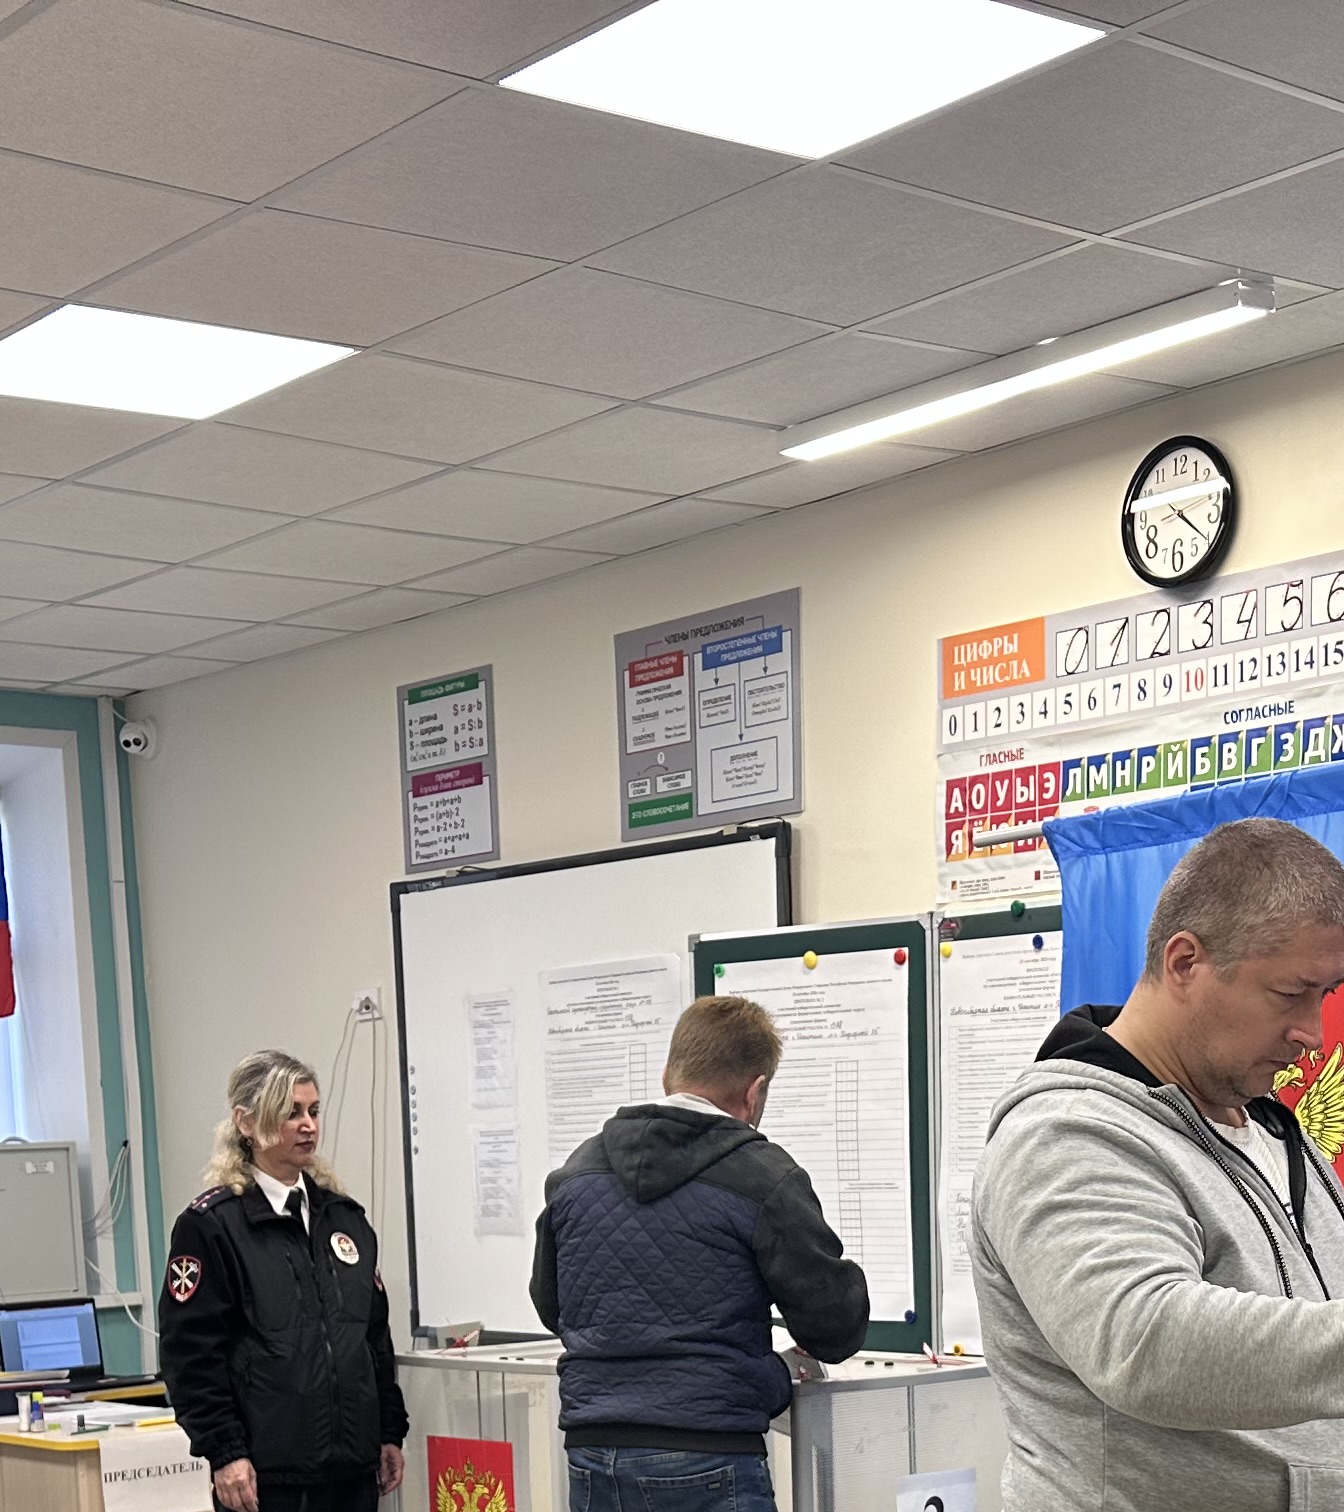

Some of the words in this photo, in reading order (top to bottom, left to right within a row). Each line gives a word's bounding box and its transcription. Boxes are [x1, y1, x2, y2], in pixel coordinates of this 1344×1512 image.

[1155, 468, 1165, 484] 11
[1173, 454, 1187, 476] 12
[1193, 460, 1199, 482] 1
[1208, 491, 1220, 523] 3
[1140, 510, 1147, 530] 9
[1146, 525, 1158, 559] 8
[1190, 537, 1198, 557] 5
[1172, 538, 1184, 572] 6
[1064, 627, 1089, 675] 0
[1110, 616, 1129, 667] 1
[1150, 609, 1170, 659] 2
[1192, 600, 1213, 649] 3
[1237, 591, 1257, 640] 4
[1281, 580, 1304, 631] 5
[953, 633, 1019, 667] ЦИФРЫ
[953, 672, 966, 691] И
[970, 658, 1031, 687] ЧИСЛА
[949, 714, 957, 736] 0
[972, 711, 978, 732] 1
[993, 706, 1002, 729] 2
[1016, 701, 1025, 724] 3
[1039, 696, 1048, 719] 4
[1063, 692, 1072, 715] 5
[1087, 687, 1097, 711] 6
[1112, 683, 1121, 706] 7
[1137, 678, 1147, 701] 8
[1163, 673, 1173, 697] 9
[1185, 667, 1204, 693] 10
[1212, 662, 1229, 688] 11
[1238, 657, 1258, 683] 12
[1266, 651, 1286, 678] 13
[1294, 645, 1315, 673] 14
[1322, 639, 1344, 667] 15
[1223, 700, 1295, 725] СОГЛАСНЫЕ
[979, 747, 1025, 767] ГЛАСНЫЕ
[949, 787, 964, 814] А
[971, 783, 986, 810] О
[995, 779, 1009, 807] У
[1016, 775, 1035, 803] Ы
[1042, 771, 1056, 799] Э
[1065, 766, 1082, 796] Л
[1088, 762, 1108, 792] М
[1116, 758, 1132, 788] Н
[1141, 755, 1156, 784] Р
[1167, 744, 1184, 780] Й
[1194, 746, 1211, 776] Б
[1222, 742, 1237, 771] В
[1250, 736, 1266, 767] Г
[1279, 732, 1294, 763] З
[1304, 727, 1326, 764] Д
[951, 830, 962, 855] Я
[104, 1460, 203, 1483] ПРЕДСЕДАТЕЛЬ
